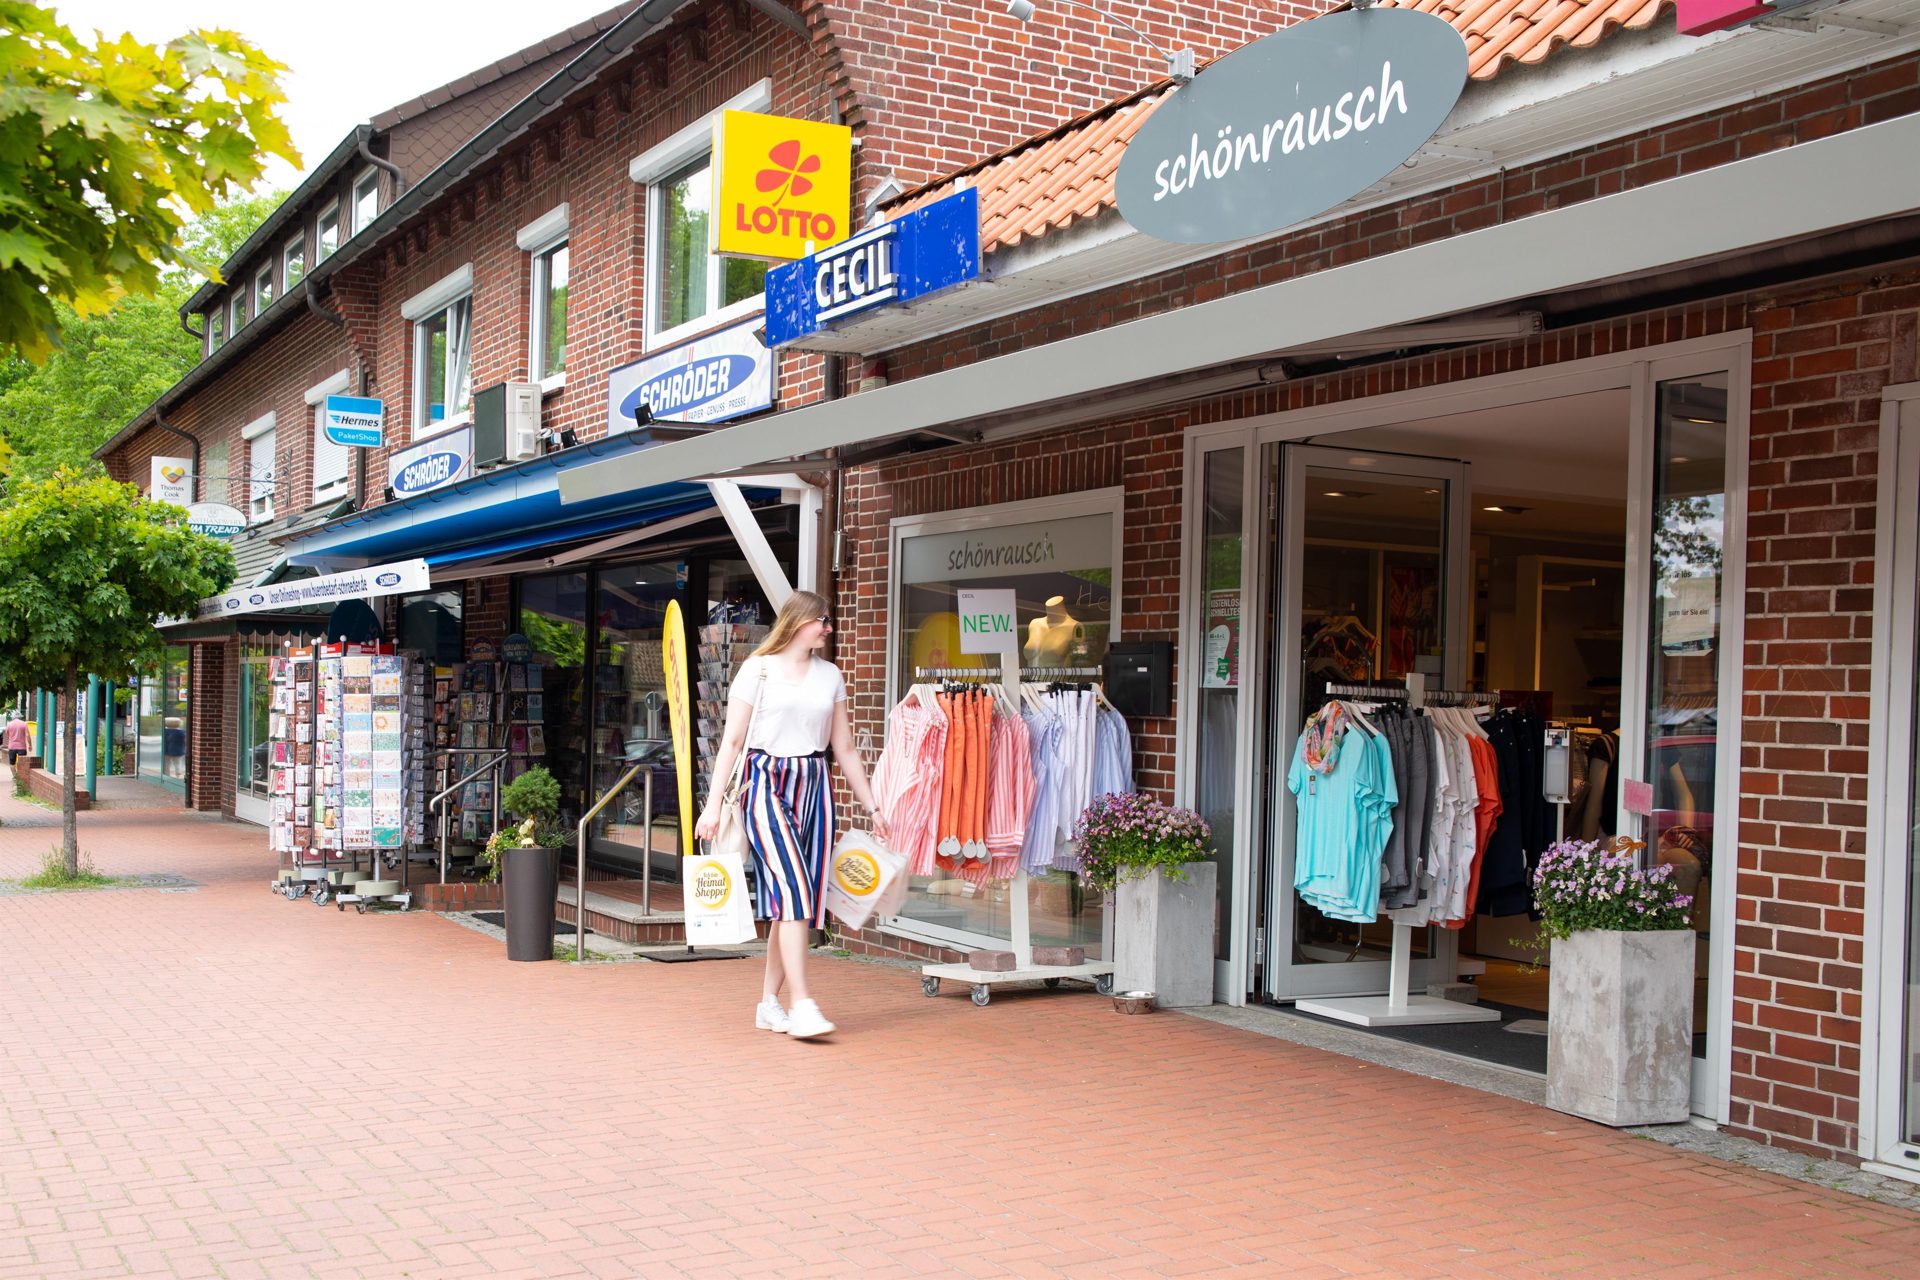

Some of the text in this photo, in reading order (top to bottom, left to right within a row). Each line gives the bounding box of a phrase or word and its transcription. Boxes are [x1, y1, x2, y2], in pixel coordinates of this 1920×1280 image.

[1153, 61, 1408, 201] schönrausch
[737, 203, 835, 241] LOTTO
[815, 240, 895, 308] CECIL
[640, 357, 731, 415] SCHRÖDER
[341, 415, 379, 427] Hermes
[338, 431, 378, 442] PaketShop
[403, 454, 450, 491] SCHRÖDER
[205, 525, 240, 536] TREND
[947, 532, 1055, 571] schönrausch
[963, 613, 1013, 633] NEW.
[695, 887, 729, 899] Shopper
[696, 877, 726, 888] Heimat
